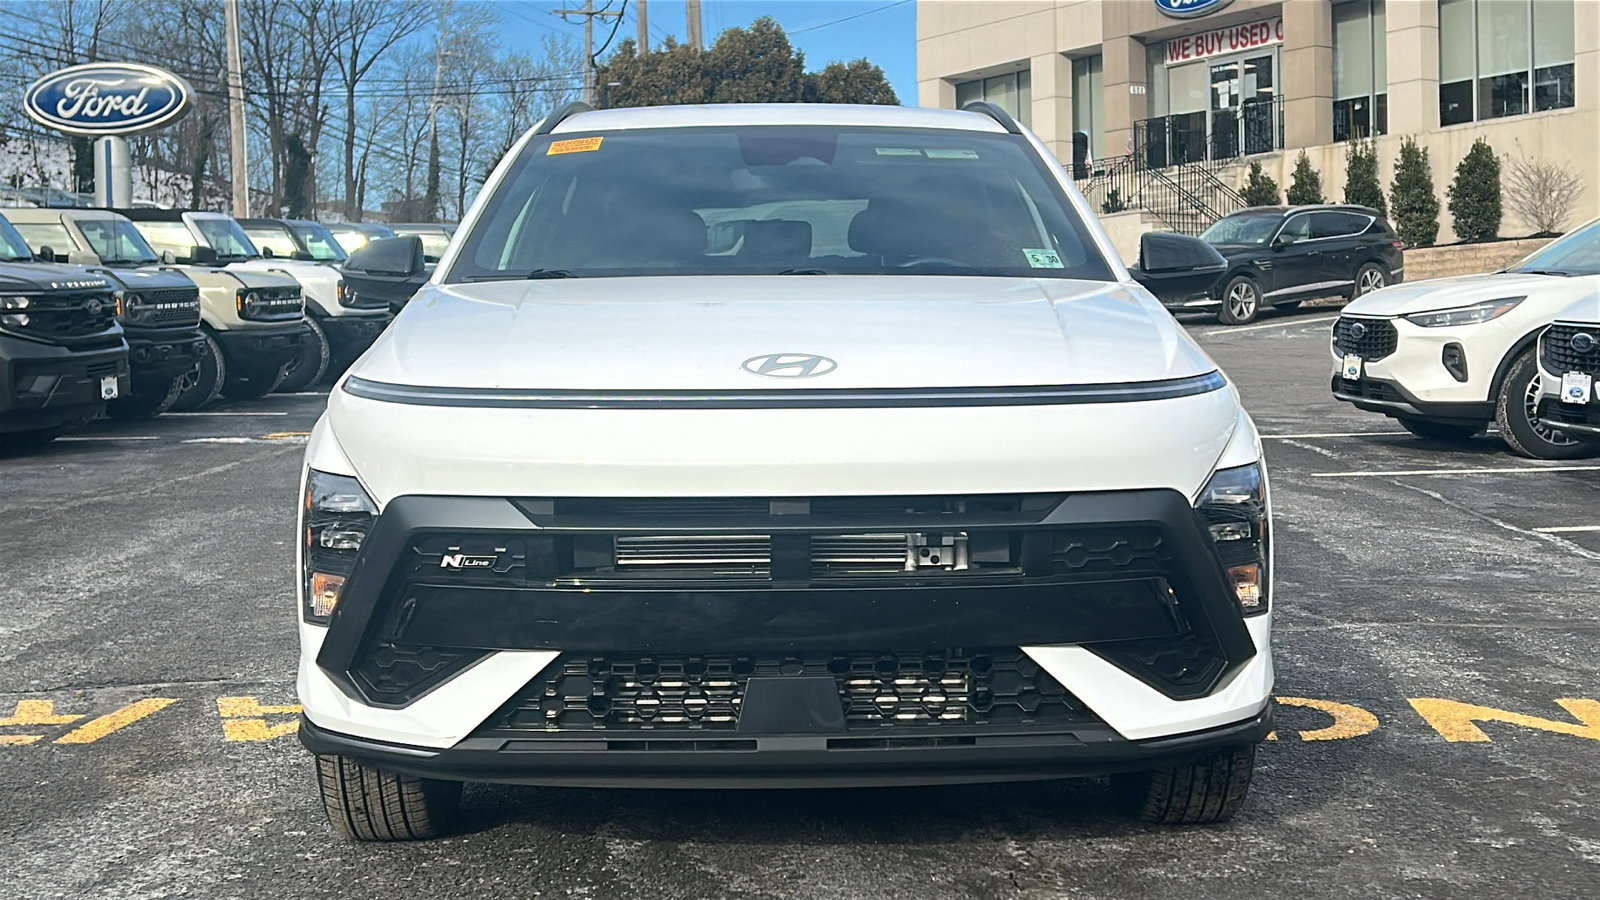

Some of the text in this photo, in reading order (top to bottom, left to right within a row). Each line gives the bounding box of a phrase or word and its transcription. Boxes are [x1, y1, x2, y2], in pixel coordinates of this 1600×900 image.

[1168, 38, 1191, 62] WE
[1195, 30, 1225, 57] BUY
[1229, 22, 1269, 49] USED
[57, 78, 149, 119] Ford
[440, 554, 464, 568] N
